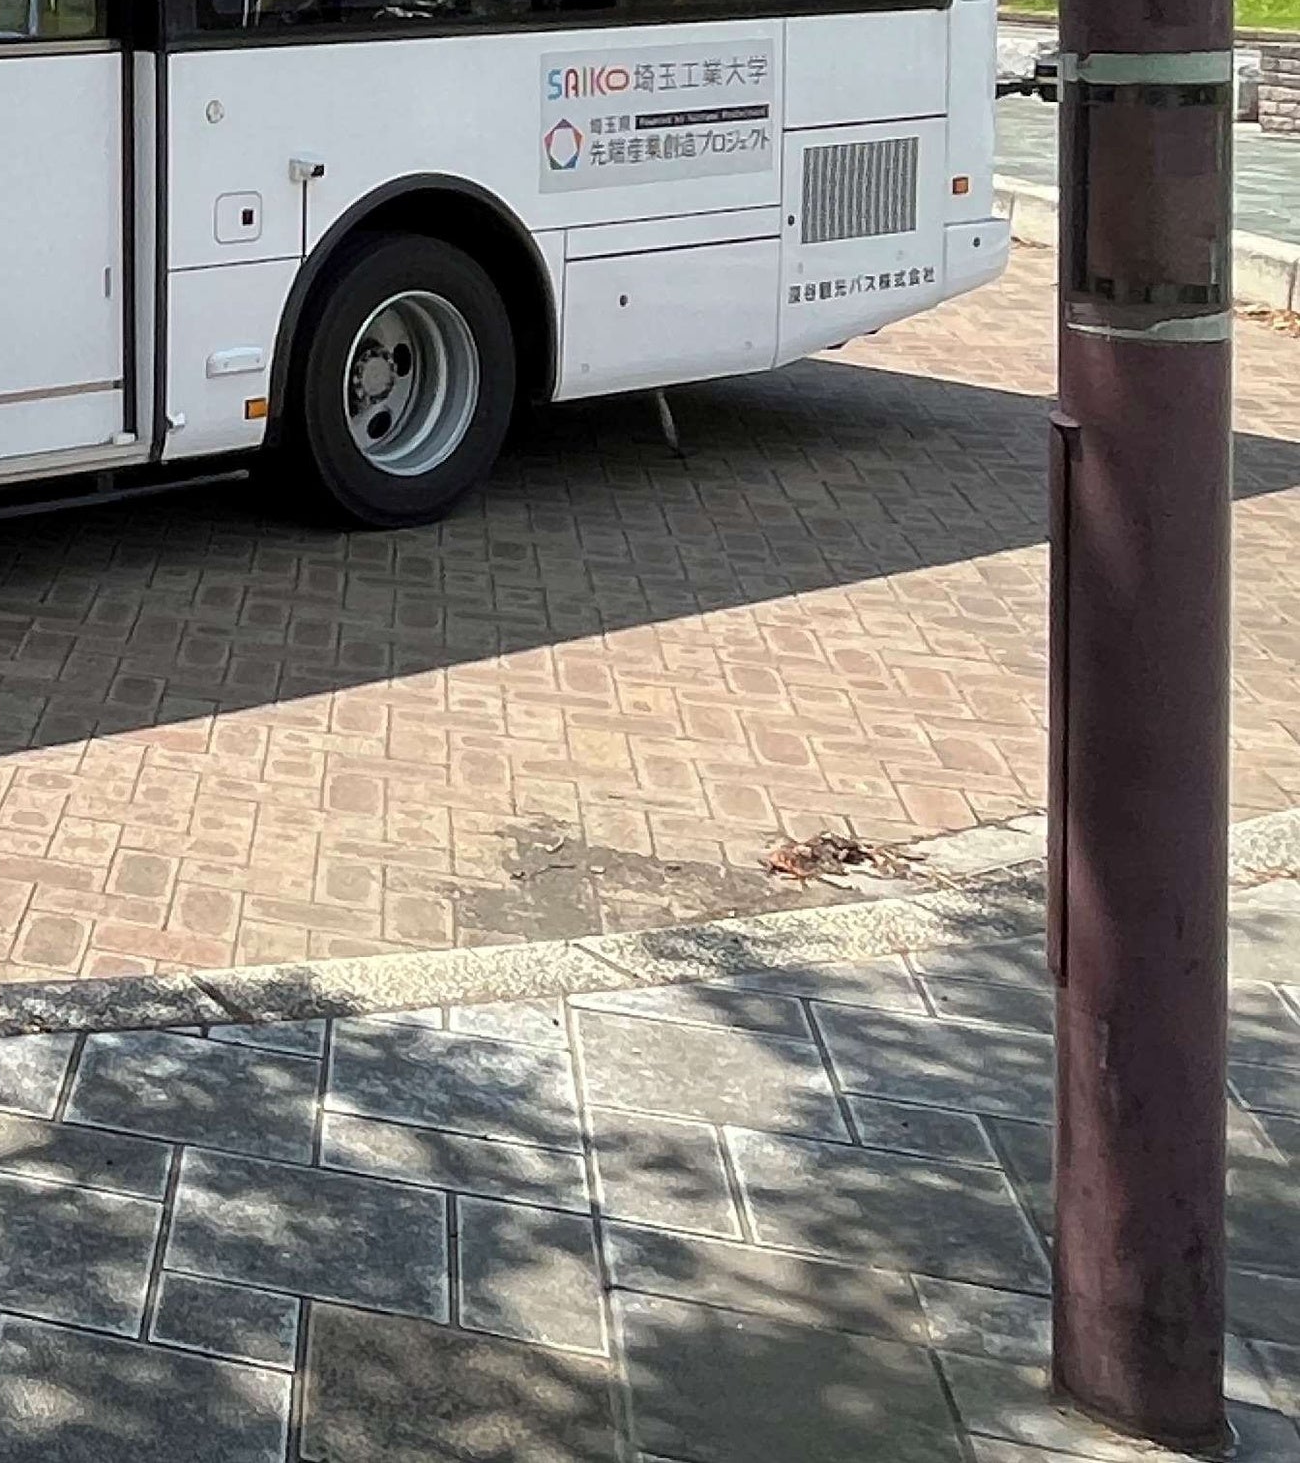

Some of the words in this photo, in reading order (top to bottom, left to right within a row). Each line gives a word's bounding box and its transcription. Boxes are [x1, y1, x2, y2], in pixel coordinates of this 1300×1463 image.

[546, 65, 630, 100] SAIKO
[633, 54, 768, 93] 埼玉工業大学
